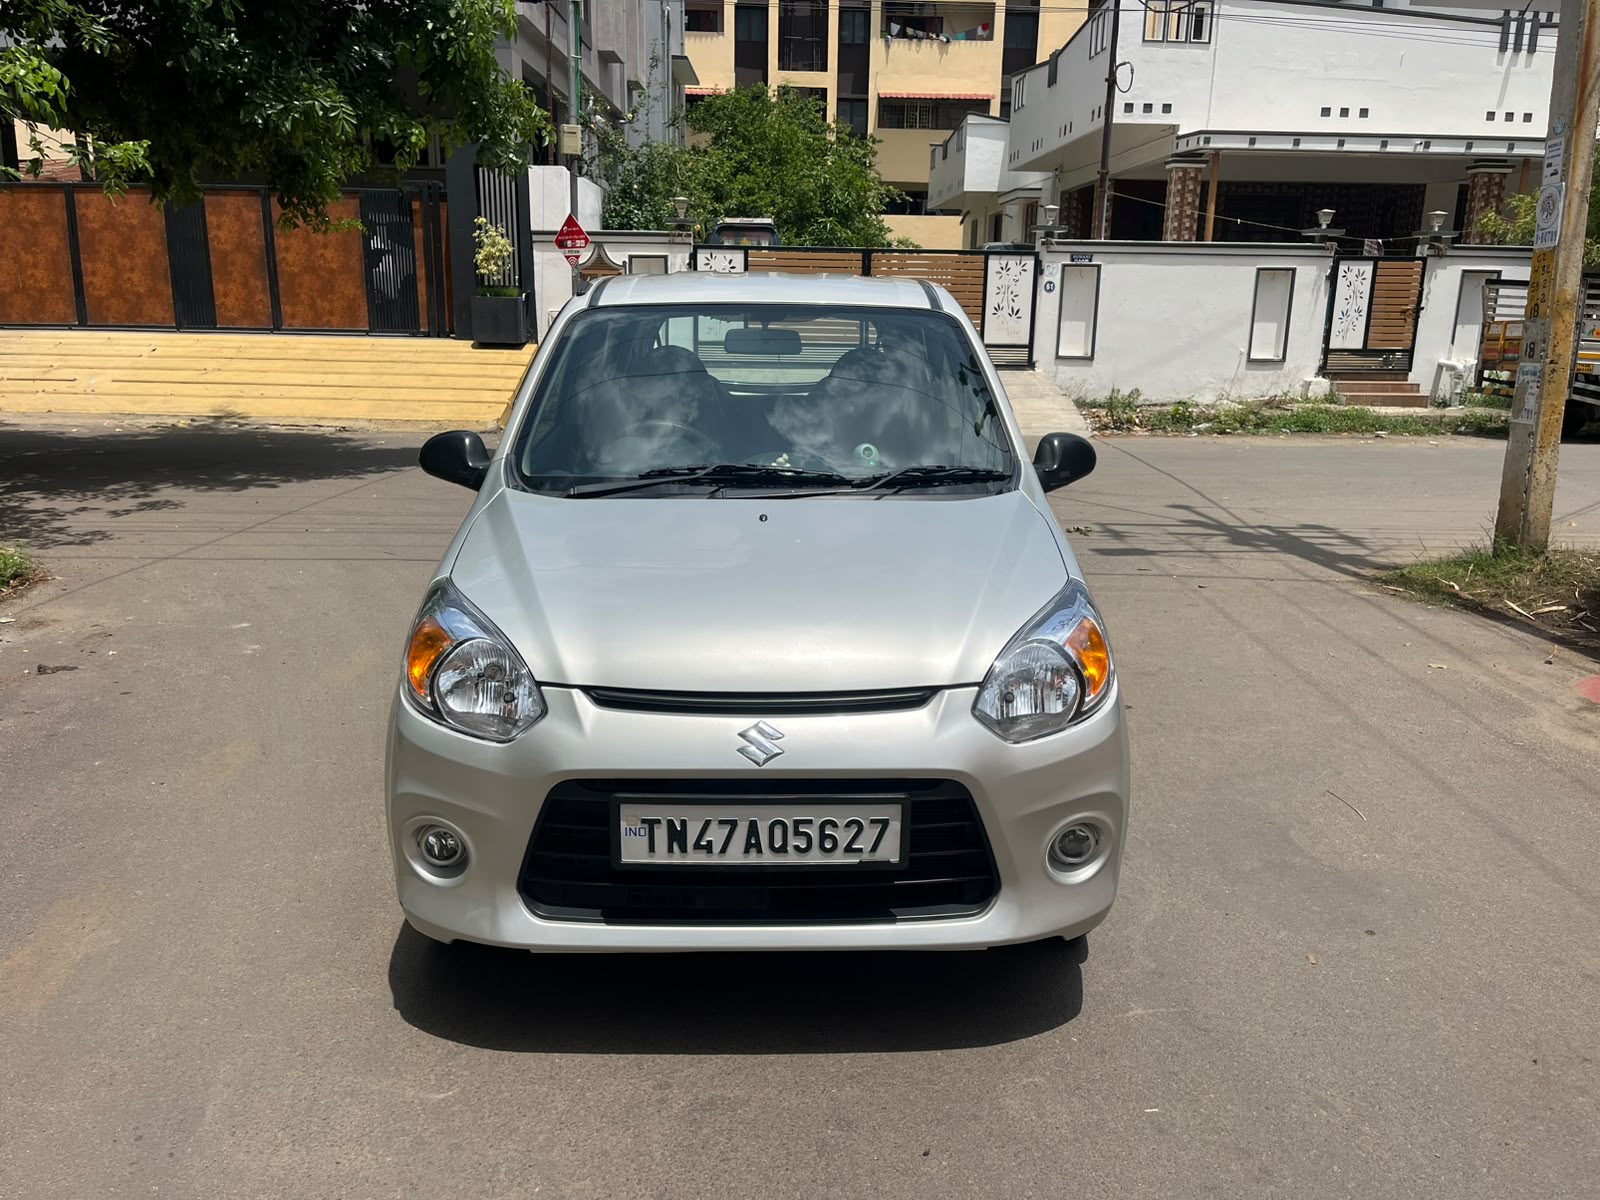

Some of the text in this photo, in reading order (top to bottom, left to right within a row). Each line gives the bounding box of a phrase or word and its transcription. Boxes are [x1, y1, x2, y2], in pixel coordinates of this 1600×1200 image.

[1524, 341, 1536, 359] 18
[624, 826, 647, 837] IND
[640, 816, 891, 855] TN47AQ5627
